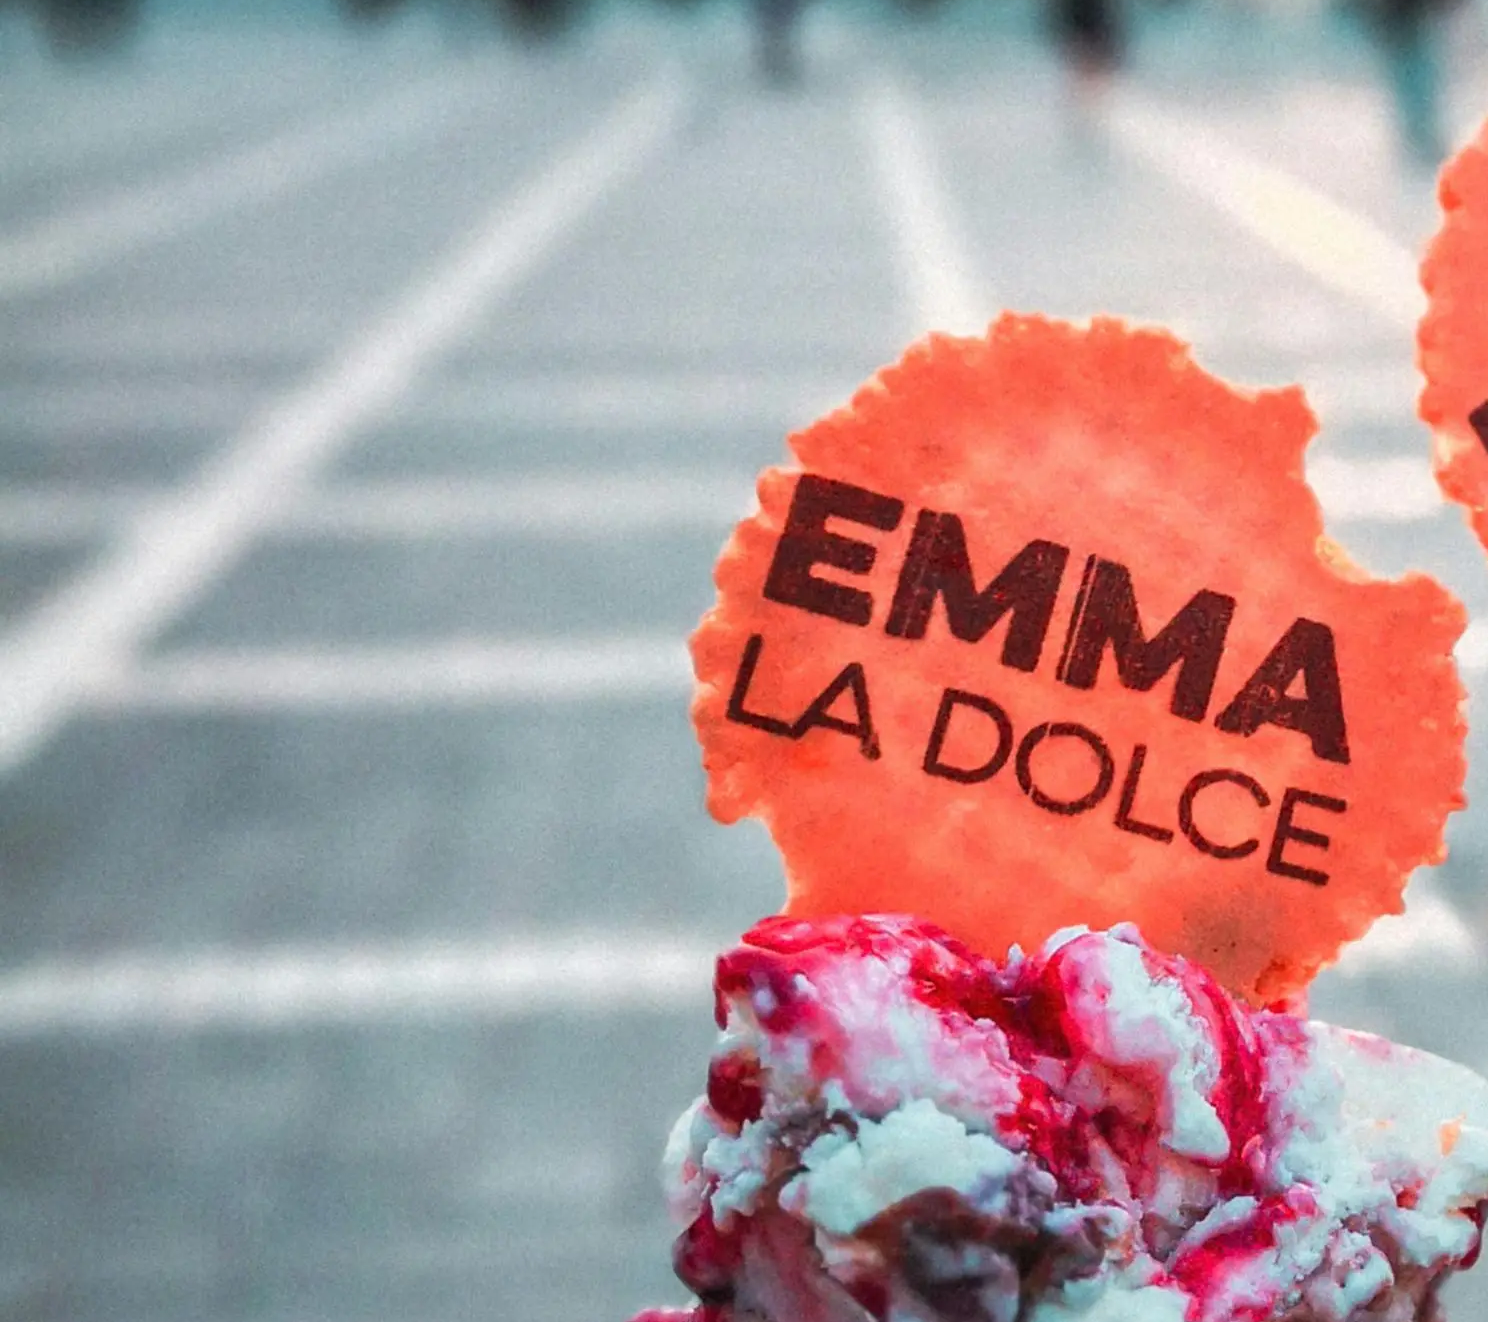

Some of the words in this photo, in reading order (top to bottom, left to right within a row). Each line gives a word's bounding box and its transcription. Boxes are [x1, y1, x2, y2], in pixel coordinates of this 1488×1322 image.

[763, 473, 1351, 765] EMMA
[725, 634, 882, 760] LA
[922, 688, 1348, 887] DOLCE
